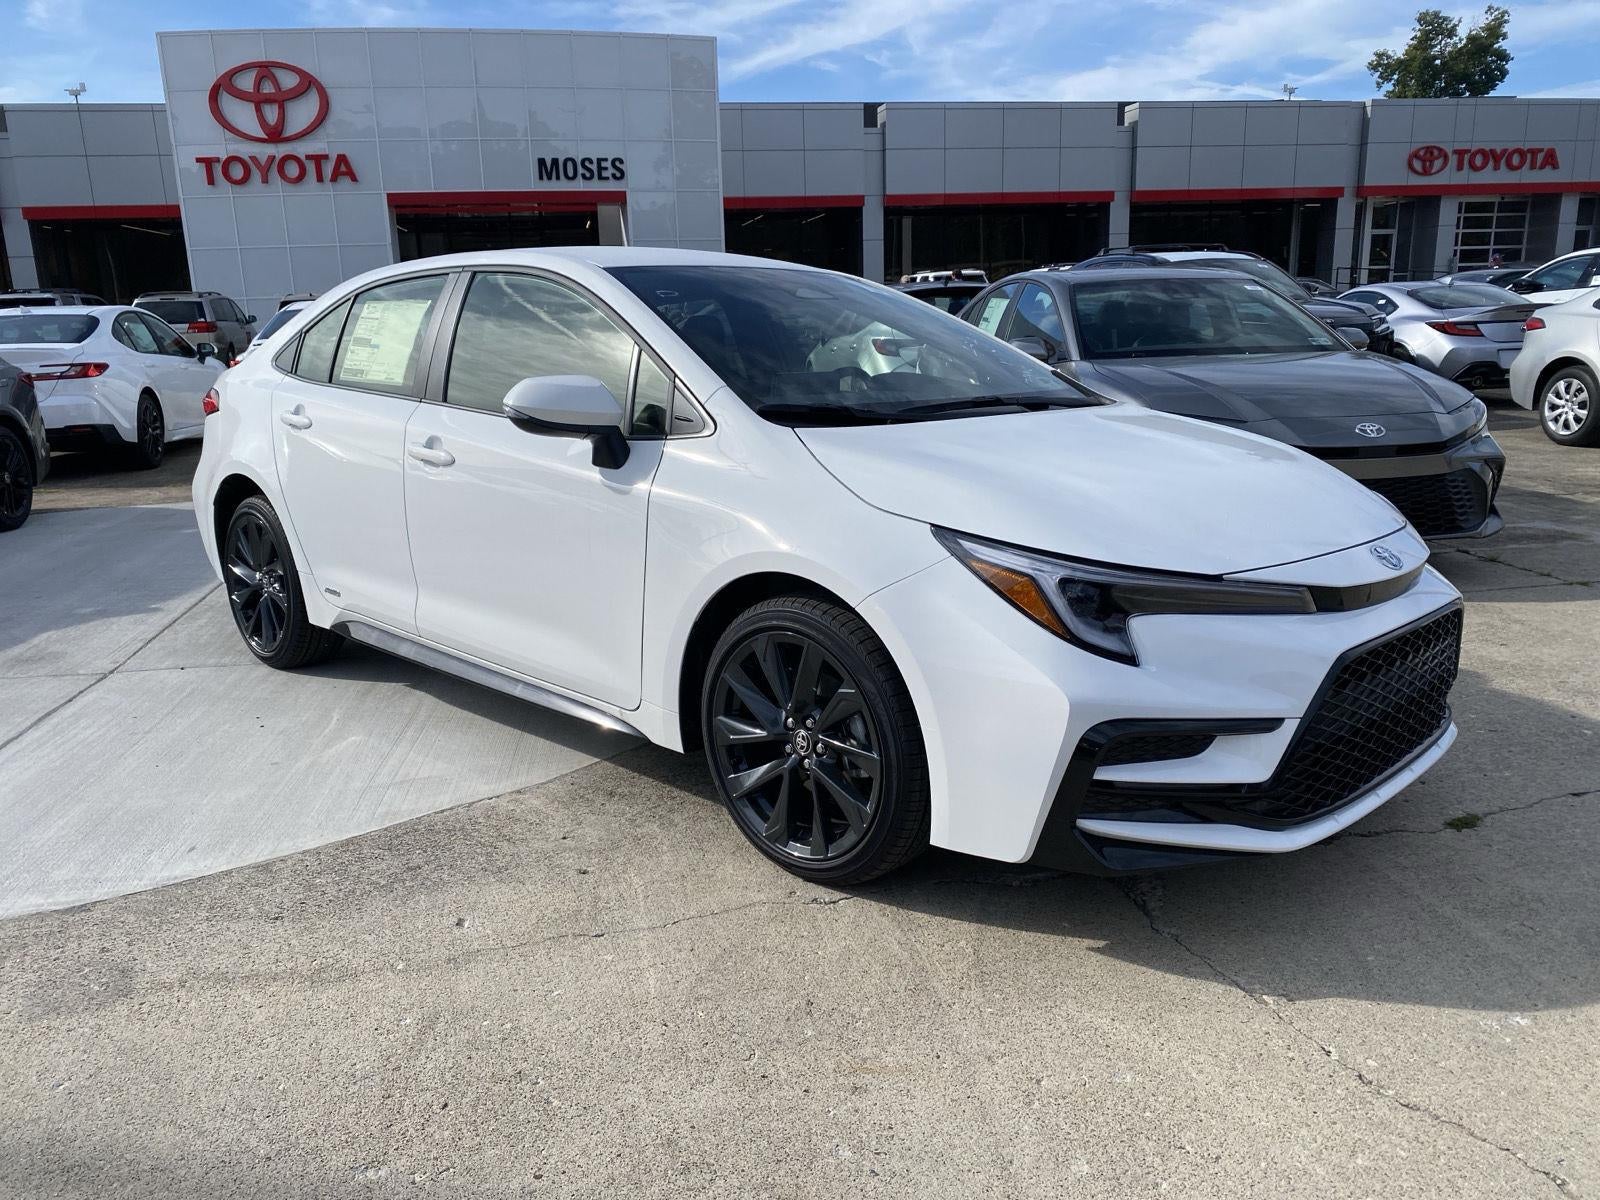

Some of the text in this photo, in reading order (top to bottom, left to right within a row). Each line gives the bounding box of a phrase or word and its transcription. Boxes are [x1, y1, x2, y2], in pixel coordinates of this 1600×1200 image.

[196, 153, 359, 186] TOYOTA
[537, 156, 626, 182] MOSES
[1453, 148, 1560, 172] TOYOTA
